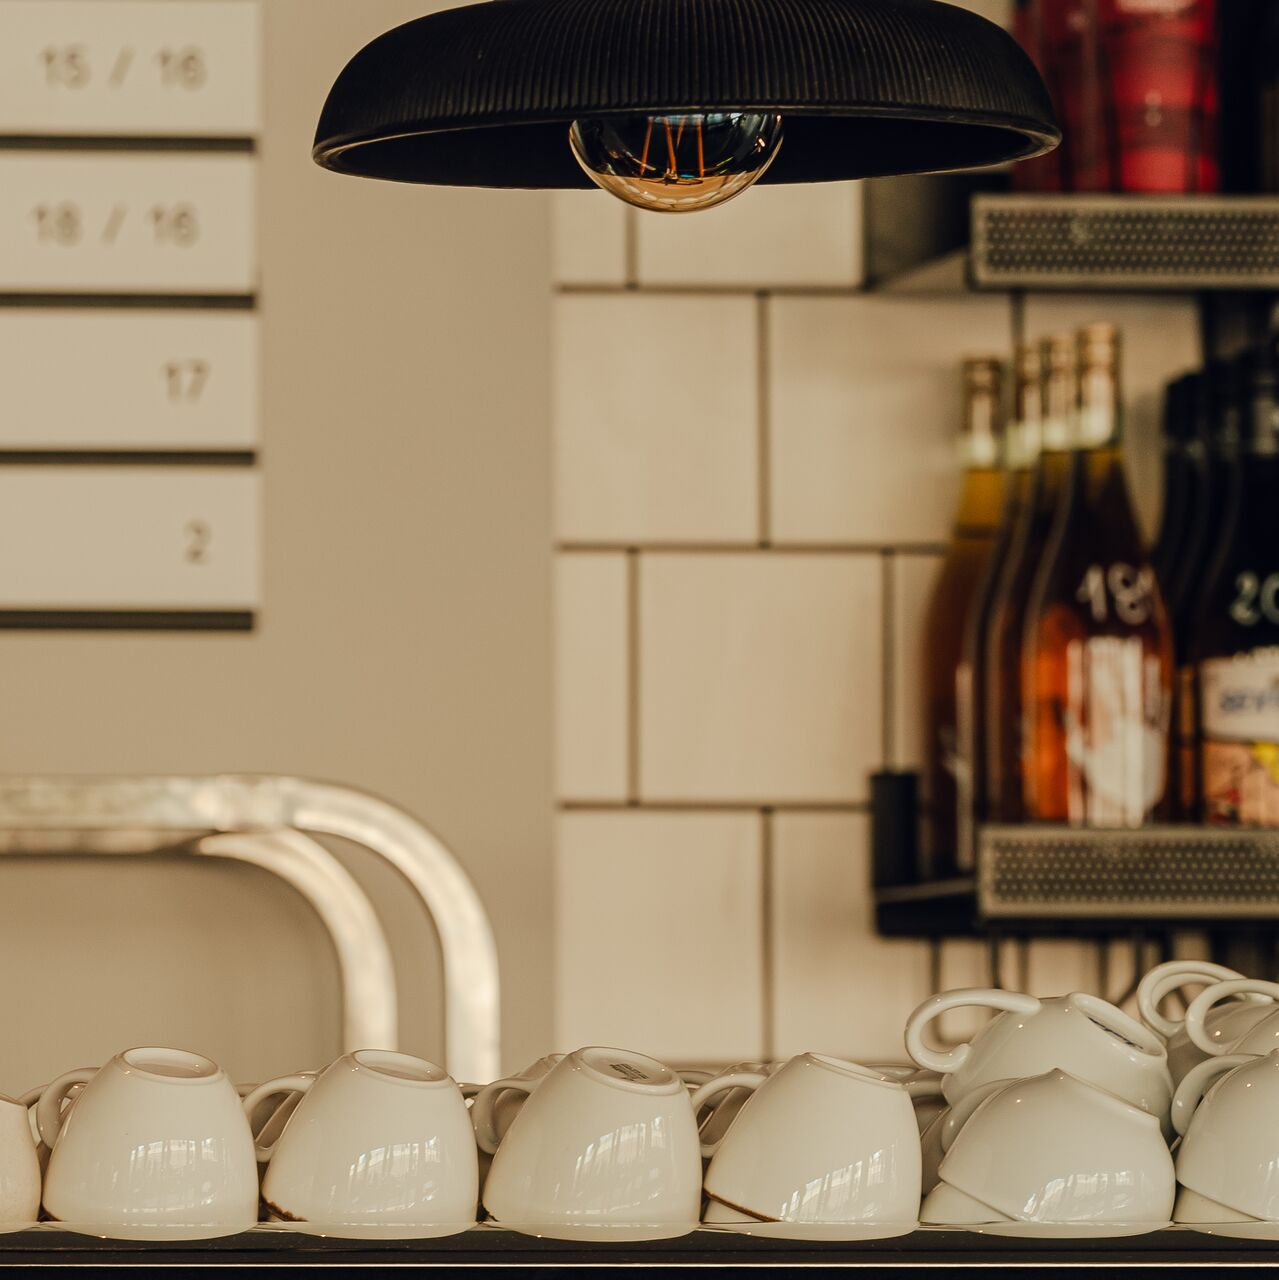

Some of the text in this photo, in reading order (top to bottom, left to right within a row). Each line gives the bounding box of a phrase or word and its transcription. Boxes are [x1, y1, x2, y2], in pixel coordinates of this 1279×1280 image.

[39, 43, 93, 92] 15
[155, 44, 210, 94] 16
[31, 201, 84, 249] 18
[148, 202, 202, 250] 16
[159, 357, 214, 406] 17
[182, 518, 215, 569] 2
